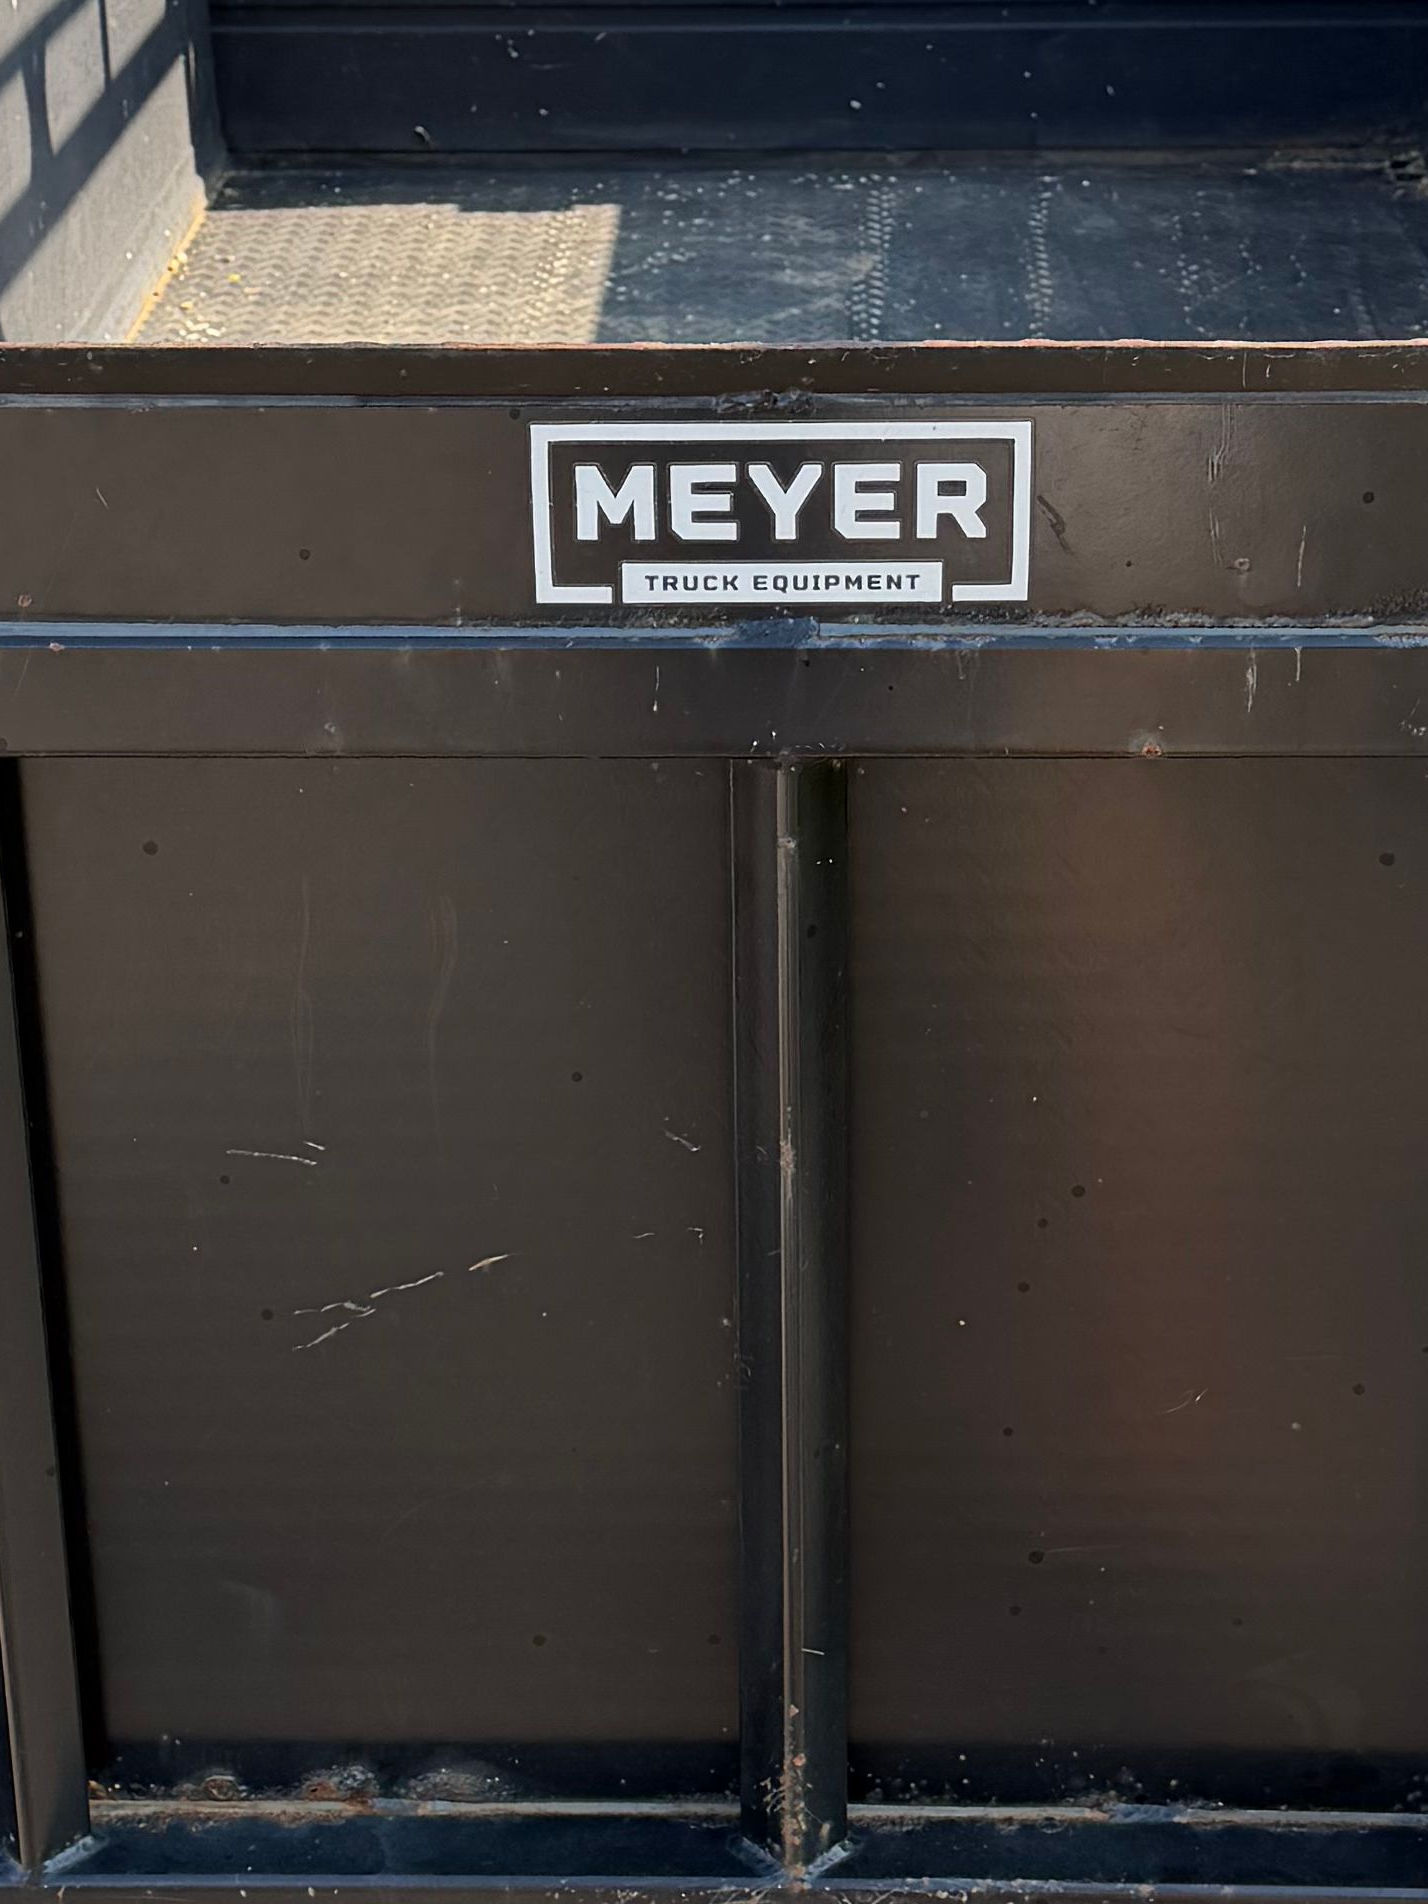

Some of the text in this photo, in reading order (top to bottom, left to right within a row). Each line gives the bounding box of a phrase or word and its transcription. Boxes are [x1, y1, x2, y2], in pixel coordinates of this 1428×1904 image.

[574, 462, 987, 541] MEYER
[645, 573, 922, 593] TRUCK EQUIPMENT
